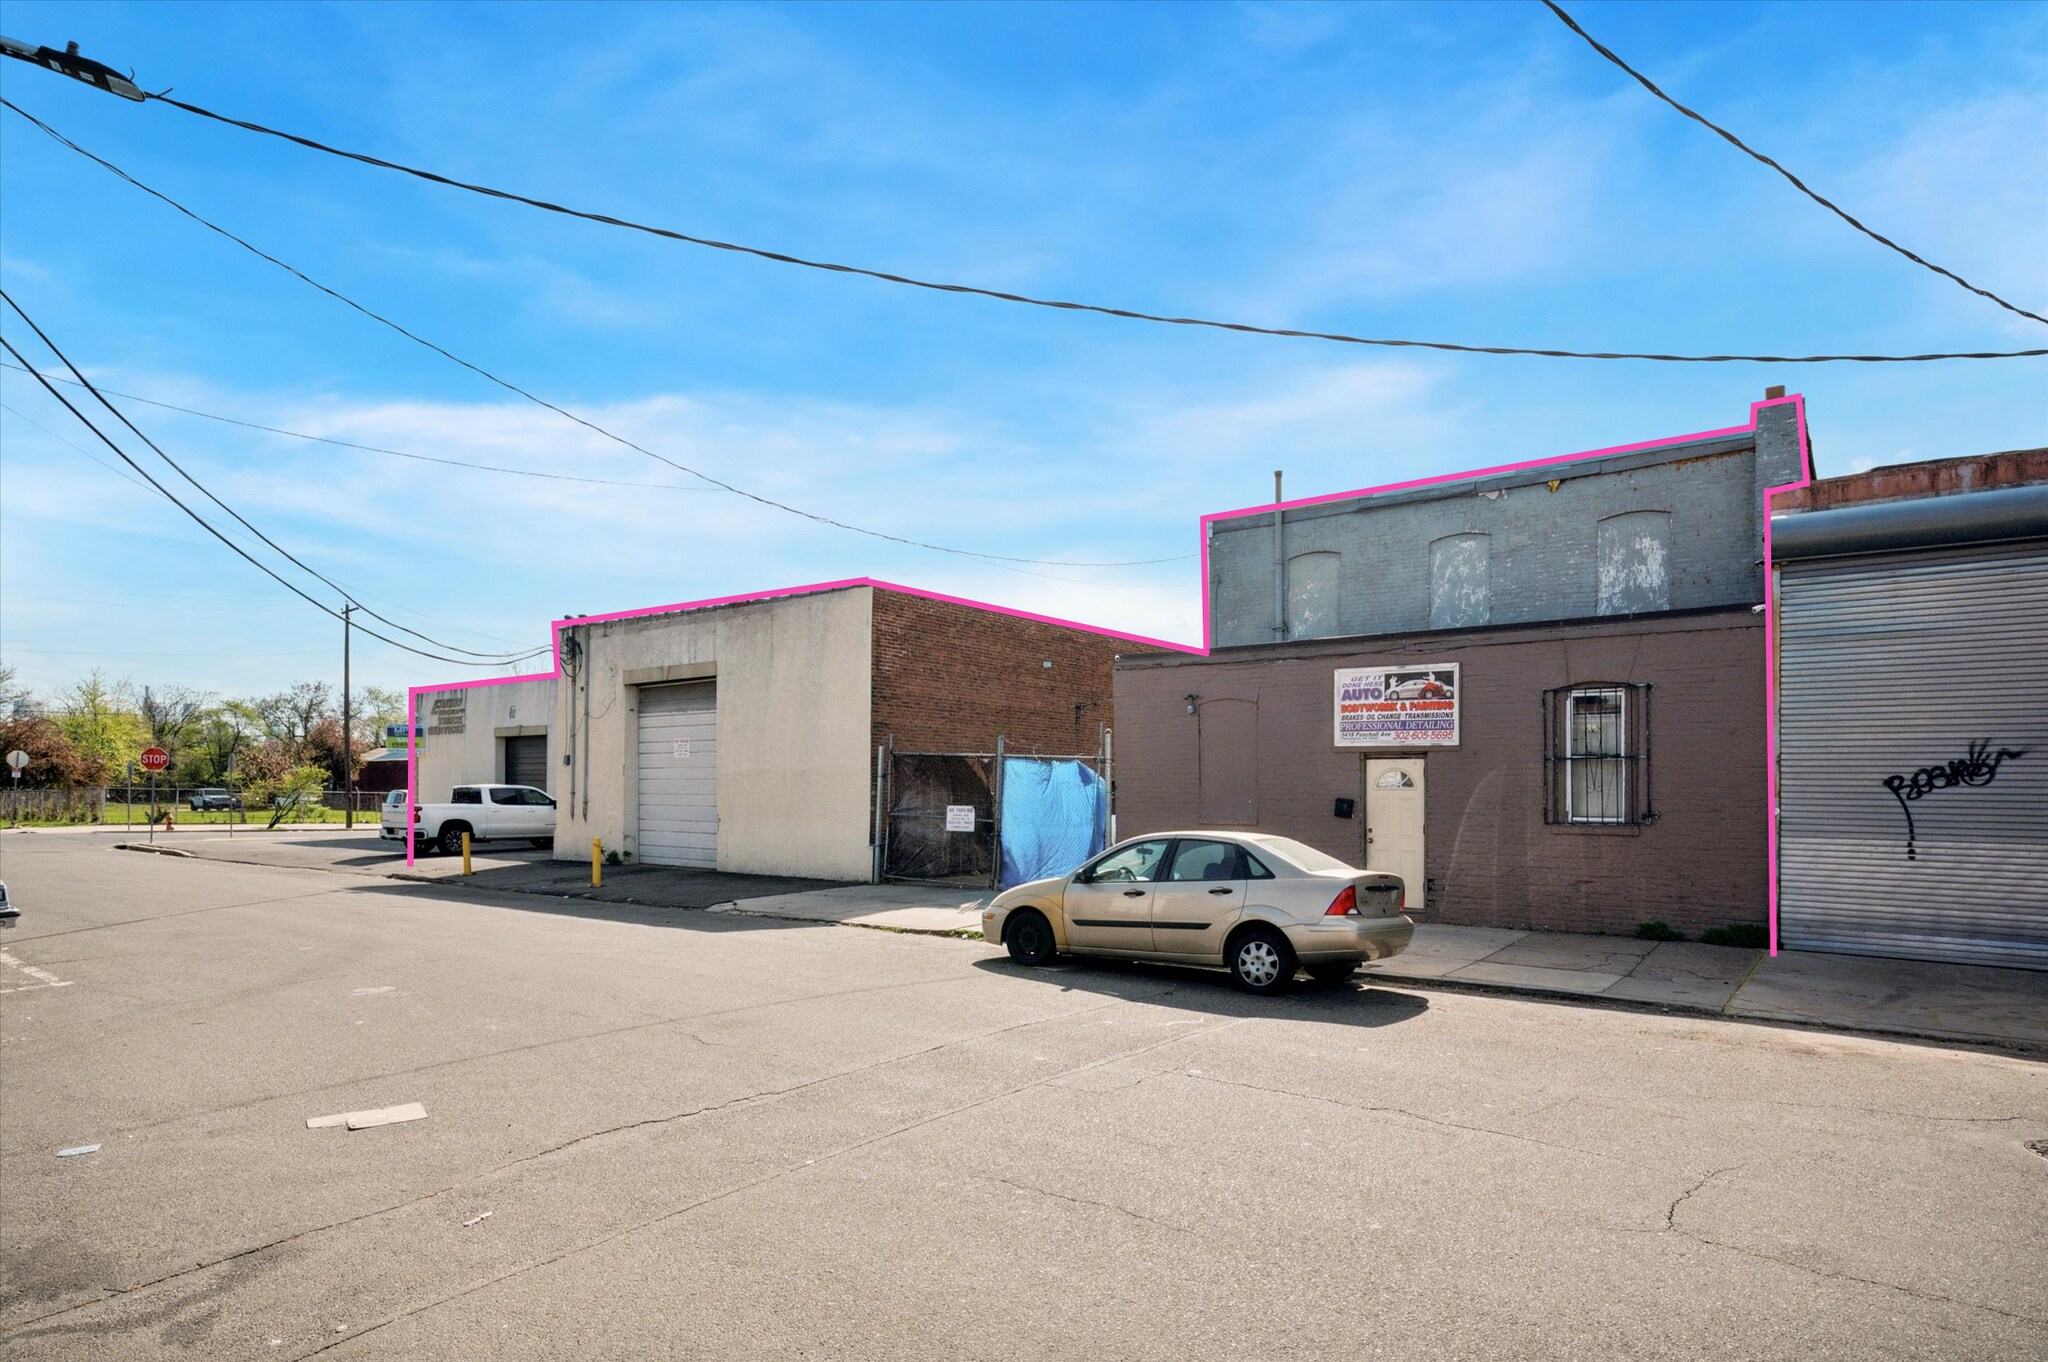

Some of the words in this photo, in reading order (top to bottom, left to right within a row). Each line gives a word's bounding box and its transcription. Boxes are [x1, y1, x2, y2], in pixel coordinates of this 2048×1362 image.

[1364, 680, 1384, 688] HERE
[1342, 688, 1383, 701] AUTO
[1399, 701, 1408, 711] &
[1409, 700, 1455, 711] PAINTING
[1341, 722, 1404, 731] PROFESSIONAL
[1405, 720, 1454, 730] DETAILING
[1393, 731, 1454, 740] 302-605-5695
[142, 754, 167, 764] STOP
